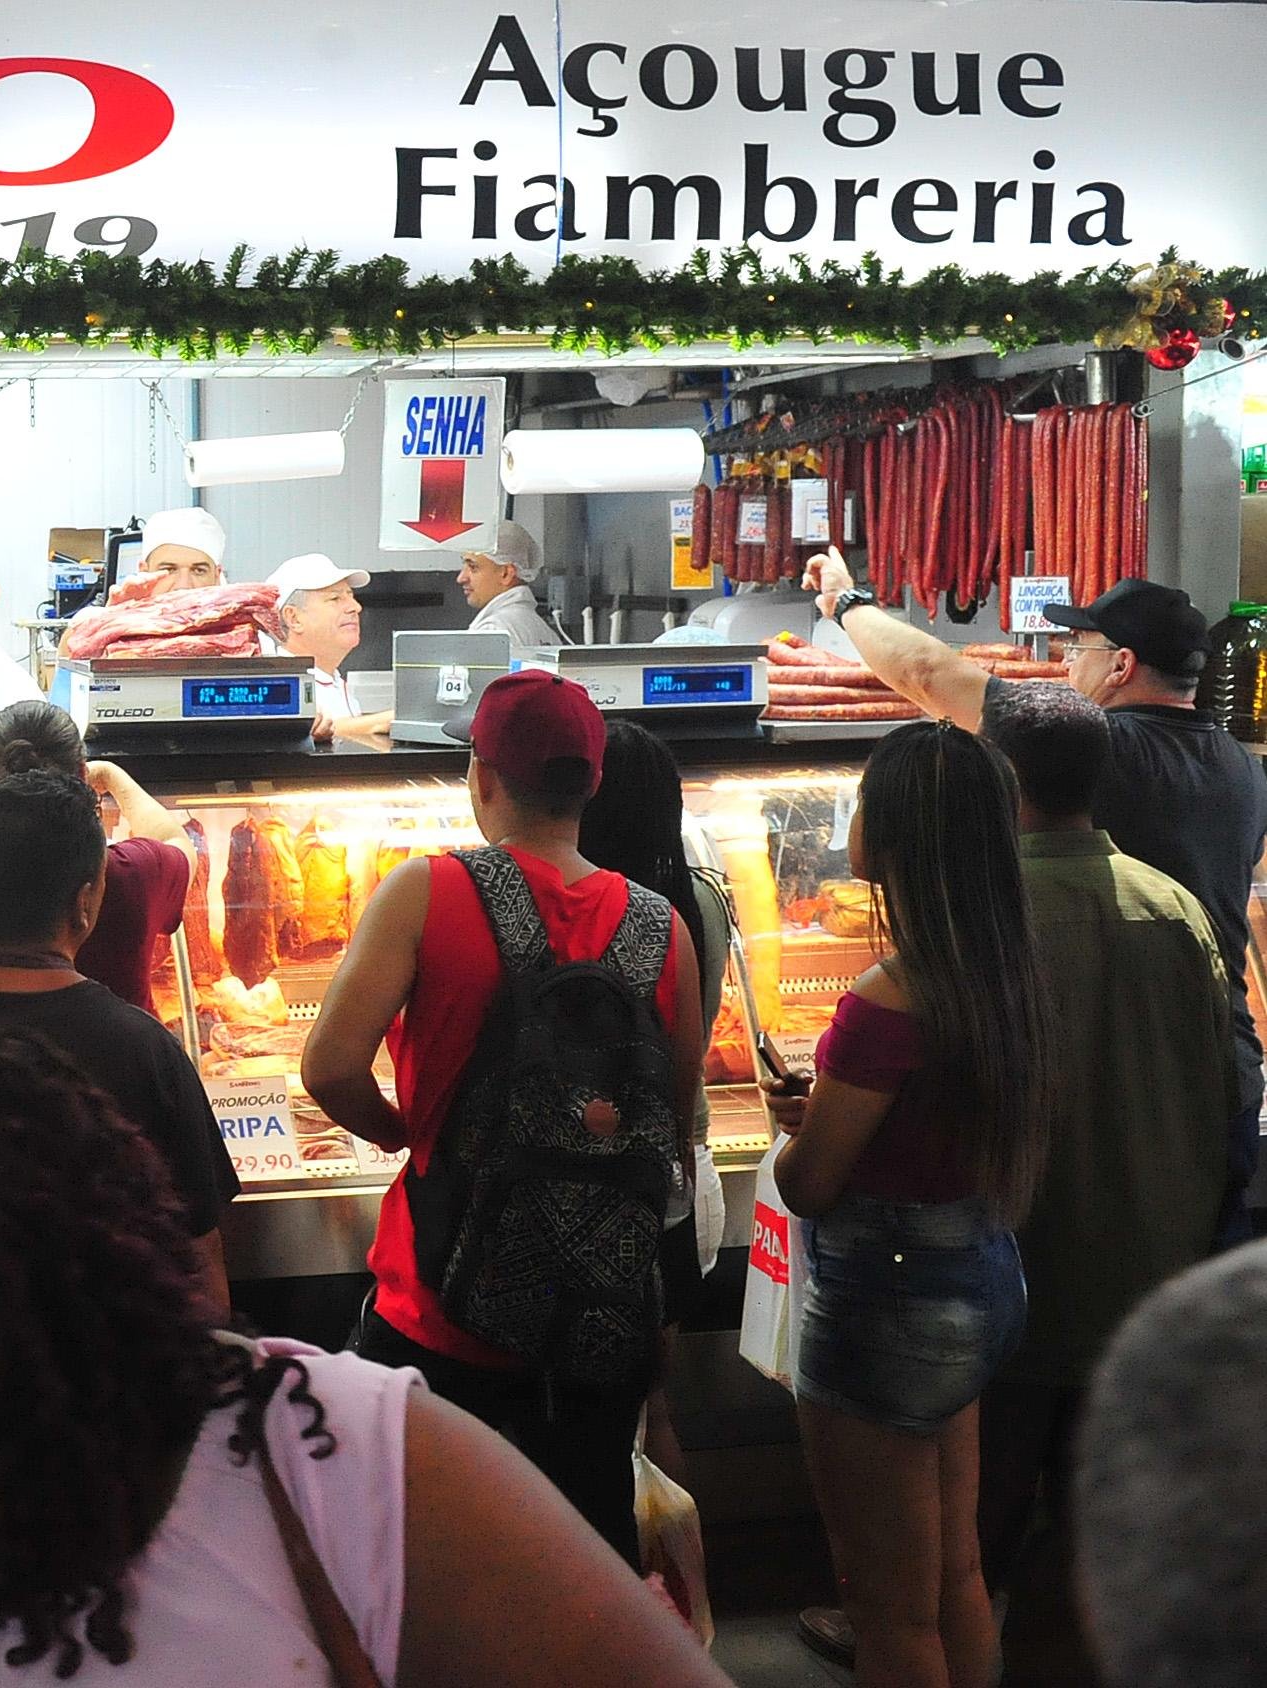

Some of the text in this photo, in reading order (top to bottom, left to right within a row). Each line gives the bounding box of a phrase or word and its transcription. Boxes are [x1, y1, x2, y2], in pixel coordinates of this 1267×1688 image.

[460, 15, 1065, 148] Açougue
[393, 141, 1133, 247] Fiambreria
[0, 211, 158, 264] 19
[402, 395, 487, 456] SENHA
[445, 681, 461, 693] 04
[96, 707, 154, 718] TOLEDO
[211, 1092, 286, 1108] PROMOÇÃO
[219, 1115, 286, 1139] RIPA
[231, 1153, 293, 1173] 29,90
